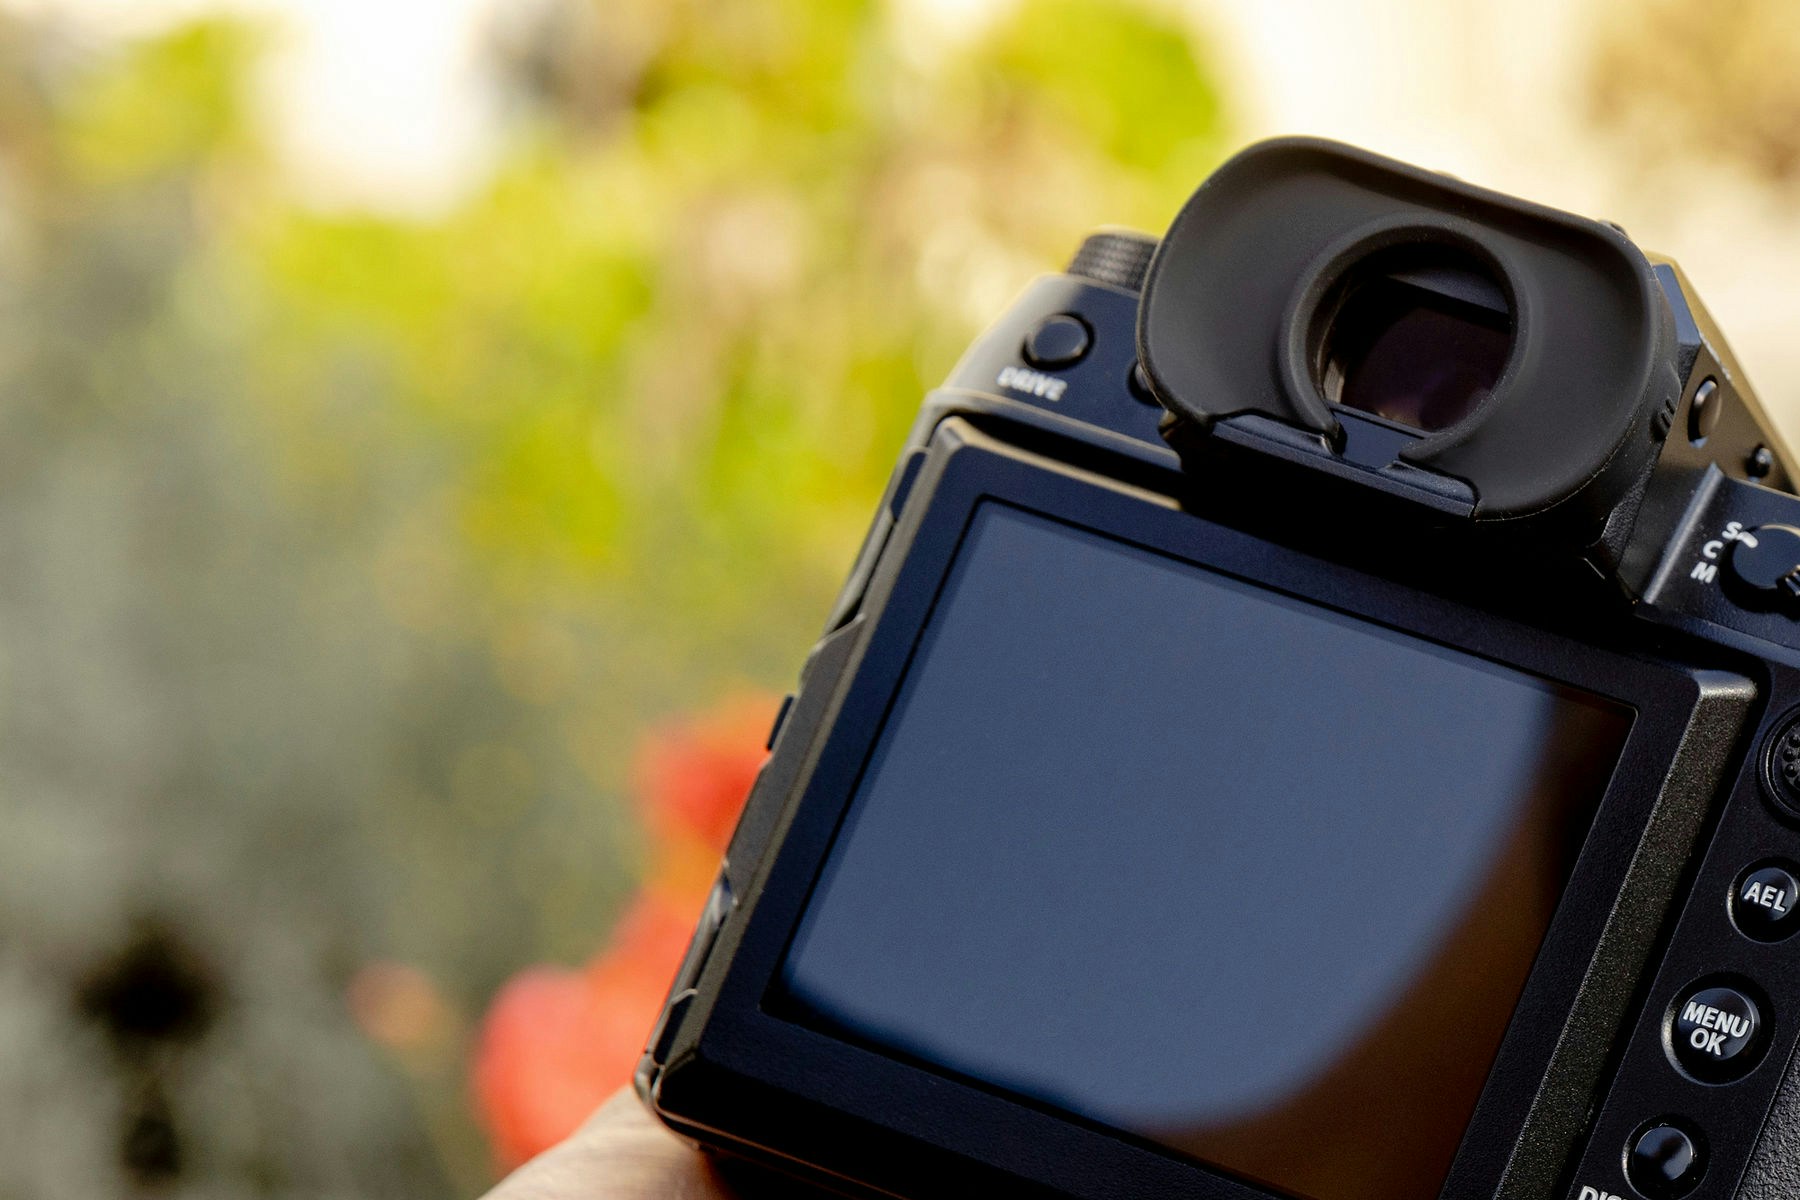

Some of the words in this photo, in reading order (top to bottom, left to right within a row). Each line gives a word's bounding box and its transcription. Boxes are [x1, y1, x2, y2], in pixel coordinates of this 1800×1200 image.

[1722, 521, 1743, 540] S
[1703, 540, 1723, 559] C
[1690, 561, 1718, 584] M
[1743, 881, 1786, 913] AEL
[1682, 1001, 1750, 1038] MENU
[1690, 1027, 1727, 1056] OK
